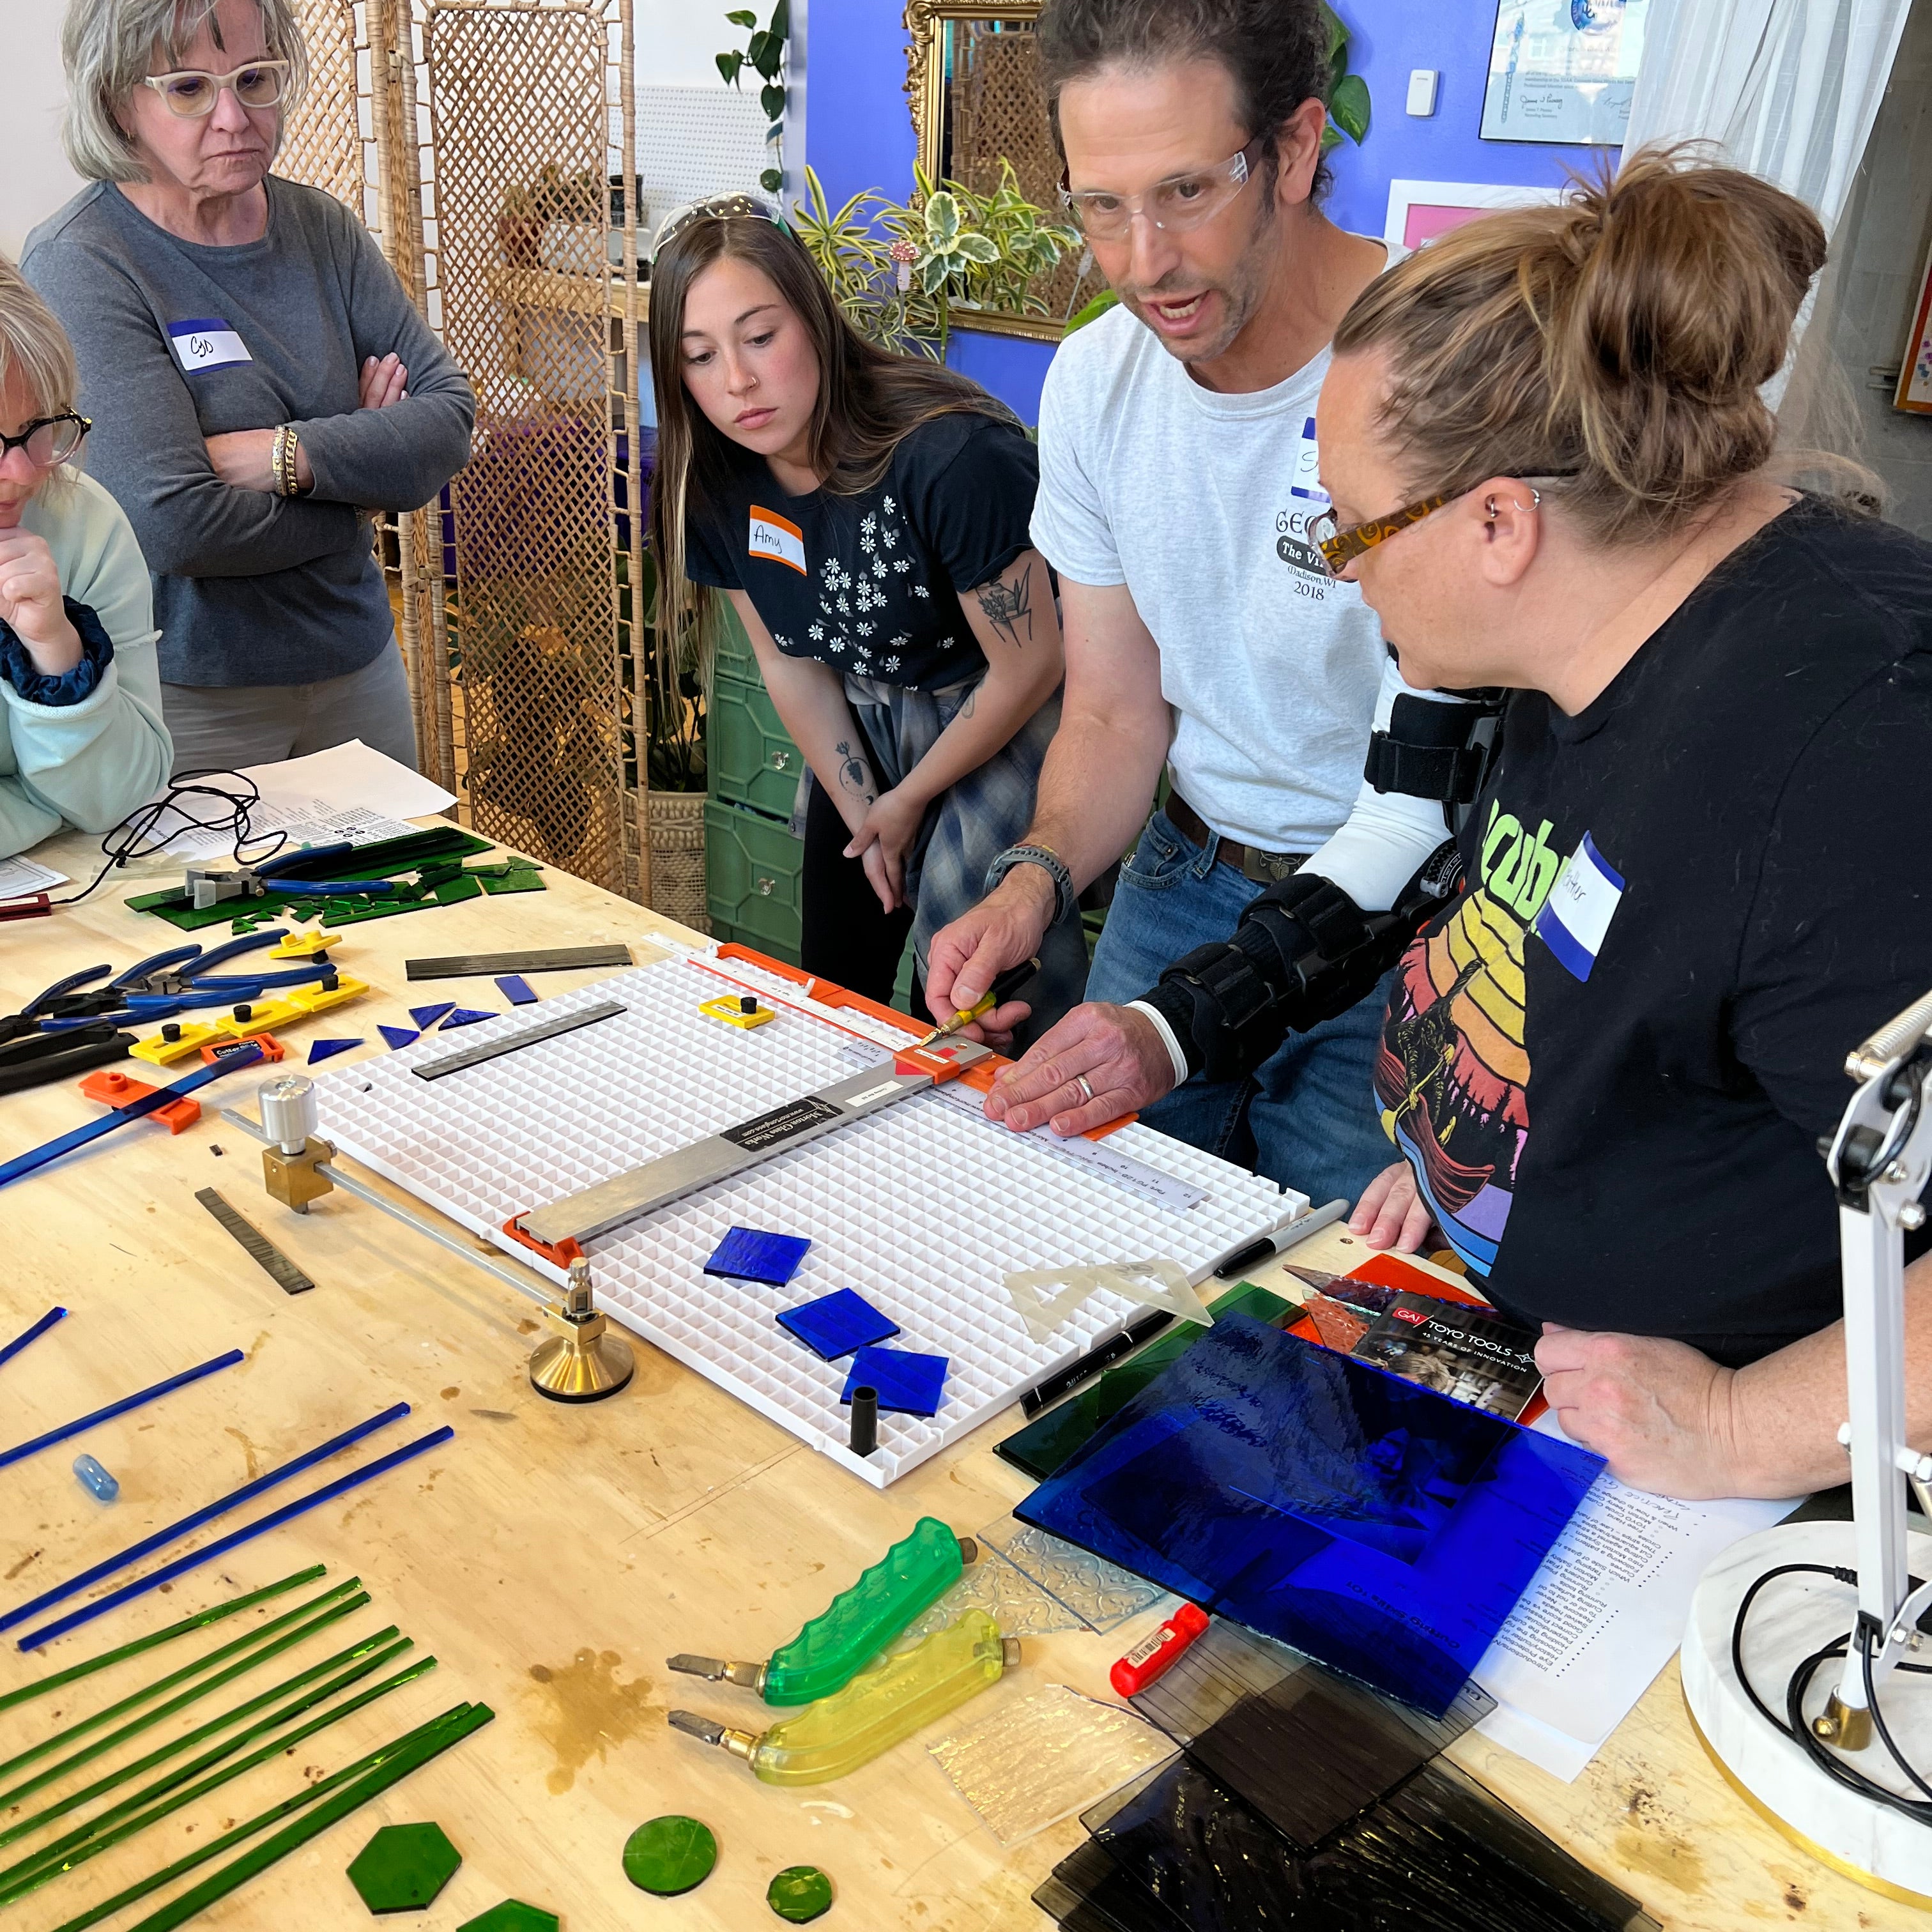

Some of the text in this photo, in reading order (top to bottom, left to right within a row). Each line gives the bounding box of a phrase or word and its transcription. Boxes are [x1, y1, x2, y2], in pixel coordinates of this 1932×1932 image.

[753, 525, 783, 554] Amy
[1282, 540, 1302, 560] The
[1293, 581, 1324, 601] 2018
[744, 1111, 823, 1145] Morton Glass Works
[1397, 1310, 1420, 1322] GAI
[1429, 1320, 1513, 1356] TOYO TOOLS
[1433, 1336, 1458, 1348] YEARS
[1473, 1351, 1528, 1372] INNOVATION
[1602, 1491, 1626, 1505] change
[1574, 1510, 1590, 1519] halv
[1584, 1496, 1646, 1529] TOYO Circle Cutte
[1627, 1511, 1652, 1524] Morton
[1635, 1508, 1650, 1517] how
[1568, 1521, 1590, 1532] straig
[1599, 1522, 1614, 1532] Law
[1607, 1513, 1643, 1533] Free Hand
[1658, 1519, 1678, 1531] When
[1563, 1545, 1582, 1556] glass
[1575, 1537, 1600, 1551] pattern
[1575, 1530, 1644, 1568] Intro Morton System
[1597, 1535, 1622, 1549] against
[1637, 1535, 1661, 1549] Circles
[1641, 1543, 1655, 1554] Thin
[1623, 1547, 1648, 1563] Cutting
[1639, 1549, 1652, 1558] Cut
[1550, 1554, 1598, 1581] Morton Safety
[1575, 1559, 1601, 1576] Tapping
[1591, 1560, 1607, 1570] Side
[1606, 1552, 1639, 1573] Following
[1610, 1563, 1634, 1577] Curves
[1541, 1565, 1588, 1591] Running Plier
[1608, 1568, 1630, 1583] Which
[1535, 1591, 1557, 1604] Never
[1550, 1583, 1602, 1613] Cutting surface
[1556, 1593, 1568, 1602] not
[1560, 1581, 1607, 1607] Running tools
[1519, 1604, 1551, 1623] Pressure
[1542, 1601, 1588, 1628] Swivel heads
[1542, 1609, 1562, 1621] score
[1563, 1606, 1593, 1623] Rescore
[1507, 1614, 1568, 1650] Holding the cutte
[1516, 1627, 1528, 1636] the
[1524, 1615, 1573, 1644] Perpendicular
[1551, 1621, 1578, 1639] Correct
[1563, 1621, 1583, 1634] Good
[1501, 1635, 1553, 1666] Eye Protection
[1511, 1633, 1558, 1660] History/cutter
[1529, 1634, 1563, 1655] Choosing
[1492, 1639, 1548, 1671] Introductions/N
